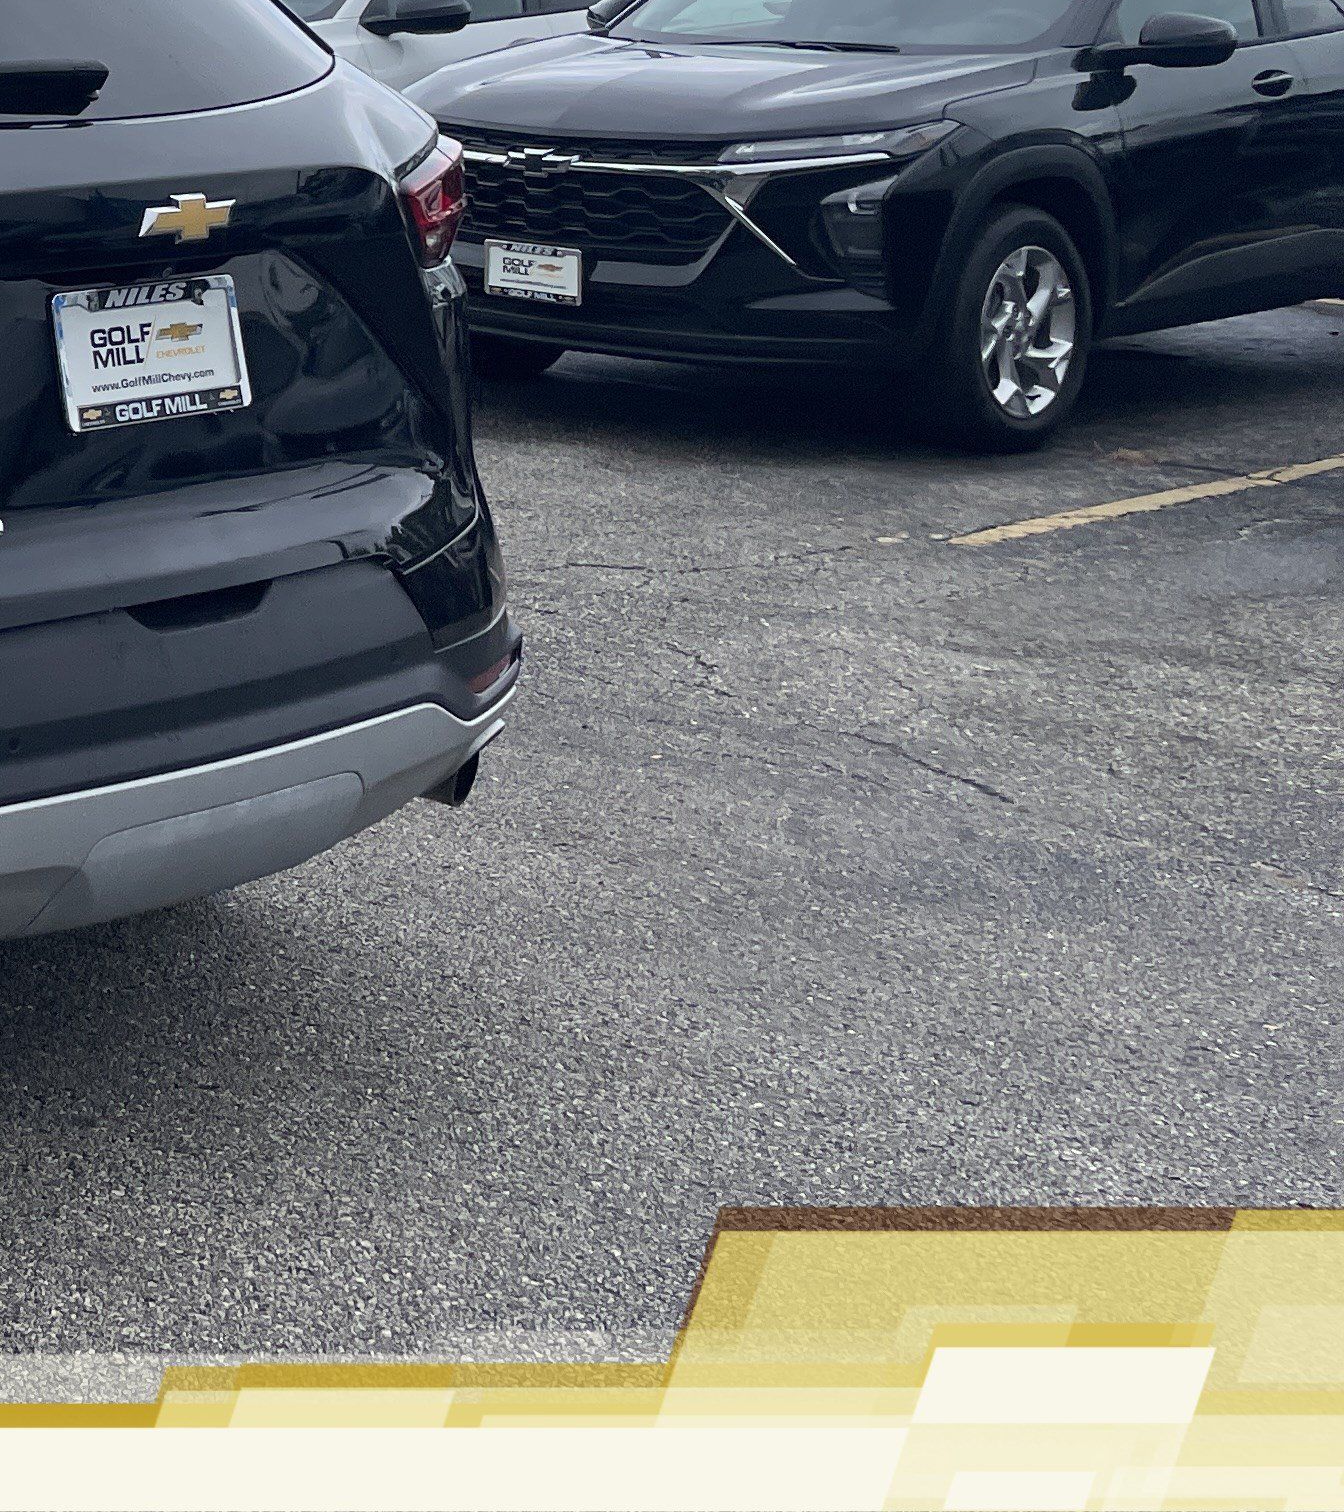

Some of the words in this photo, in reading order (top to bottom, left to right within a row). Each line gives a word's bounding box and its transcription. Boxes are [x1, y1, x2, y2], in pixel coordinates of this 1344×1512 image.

[105, 282, 187, 308] NILES
[90, 322, 152, 349] GOLF
[92, 345, 145, 370] MILL
[156, 345, 206, 360] CHEVROLET
[92, 368, 215, 393] www.GolfMillChevy.com
[115, 400, 162, 422] GOLF
[164, 393, 208, 415] MILL
